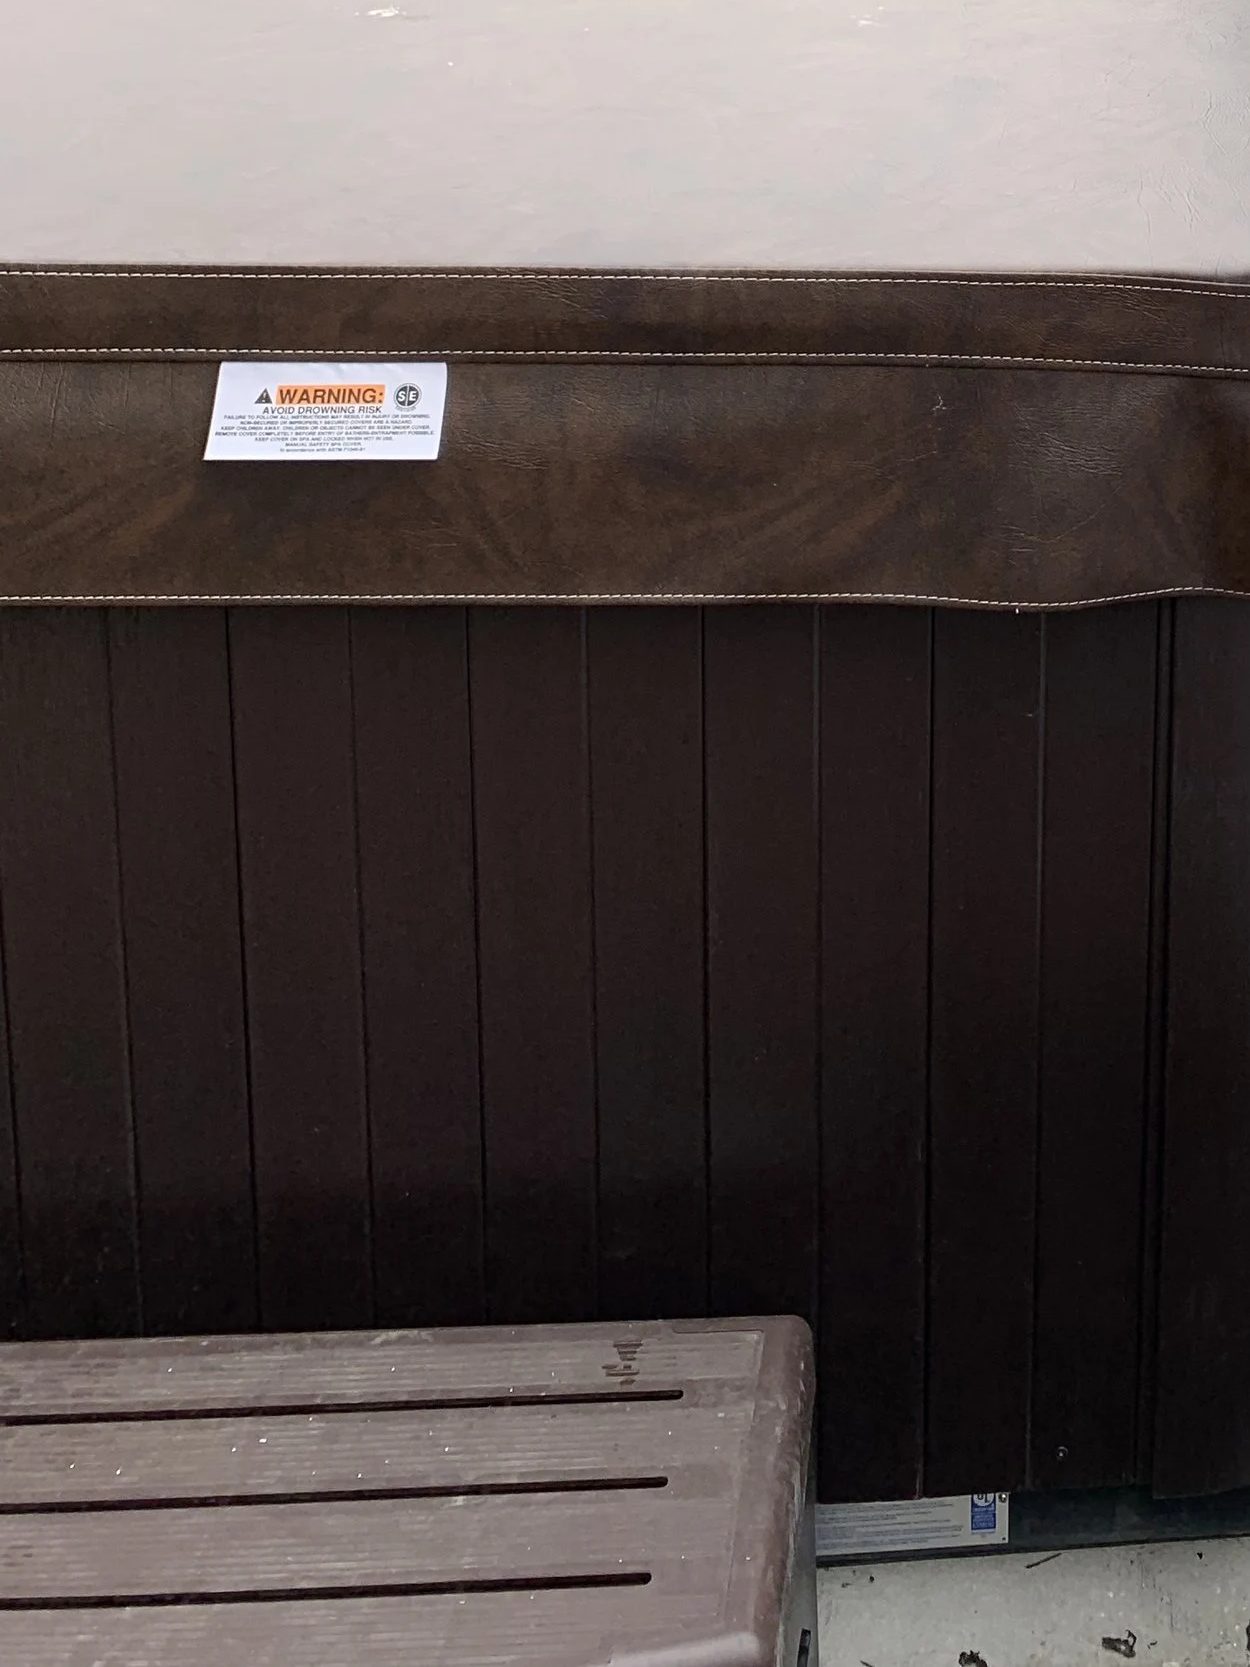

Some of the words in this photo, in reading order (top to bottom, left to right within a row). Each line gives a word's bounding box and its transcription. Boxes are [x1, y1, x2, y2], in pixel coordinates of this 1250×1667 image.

[279, 388, 384, 404] WARNING:
[263, 406, 295, 415] AVOID
[298, 406, 356, 415] DROWNING
[358, 405, 382, 414] RISK
